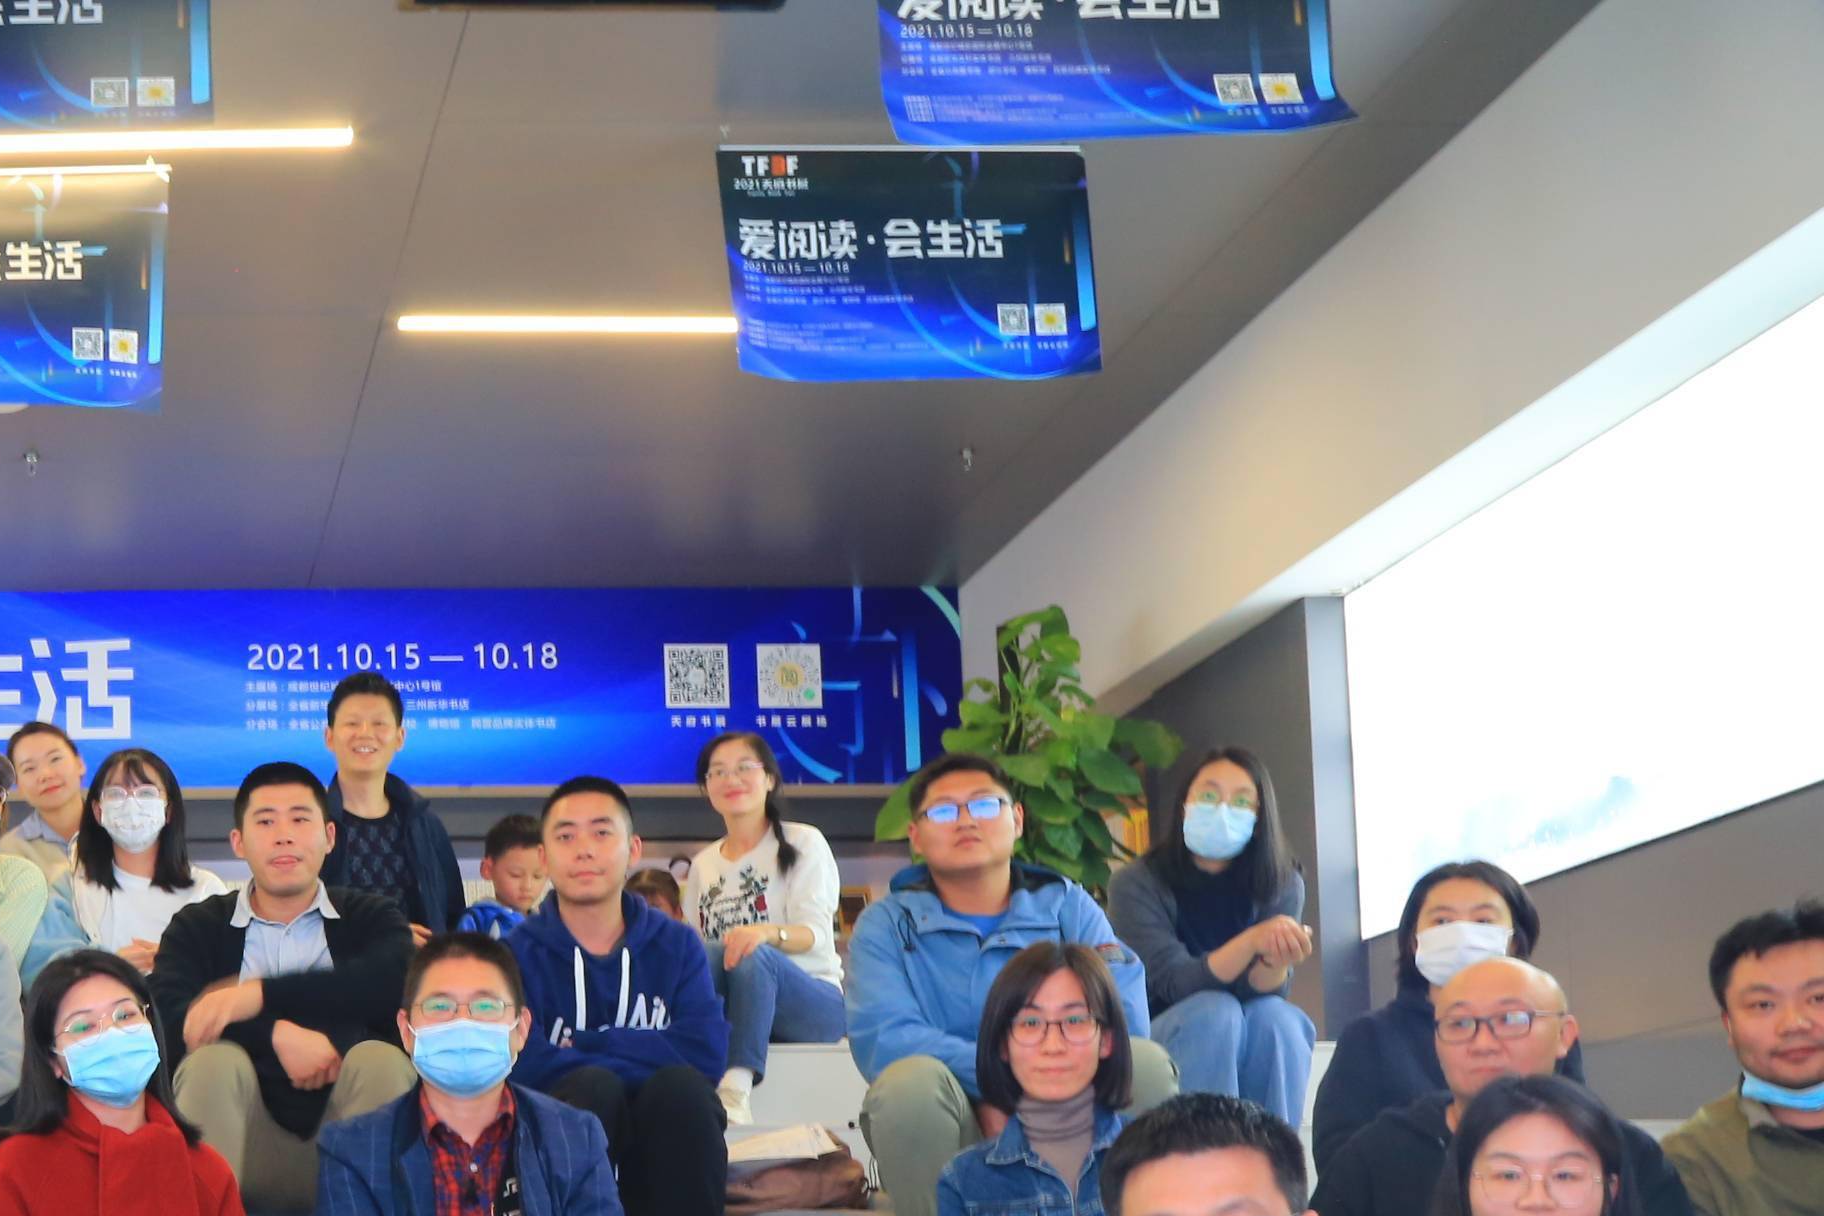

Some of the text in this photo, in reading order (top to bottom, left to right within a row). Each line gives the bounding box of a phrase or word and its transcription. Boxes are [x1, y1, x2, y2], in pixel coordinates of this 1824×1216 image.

[739, 218, 1004, 261] 爱阅读·会生活
